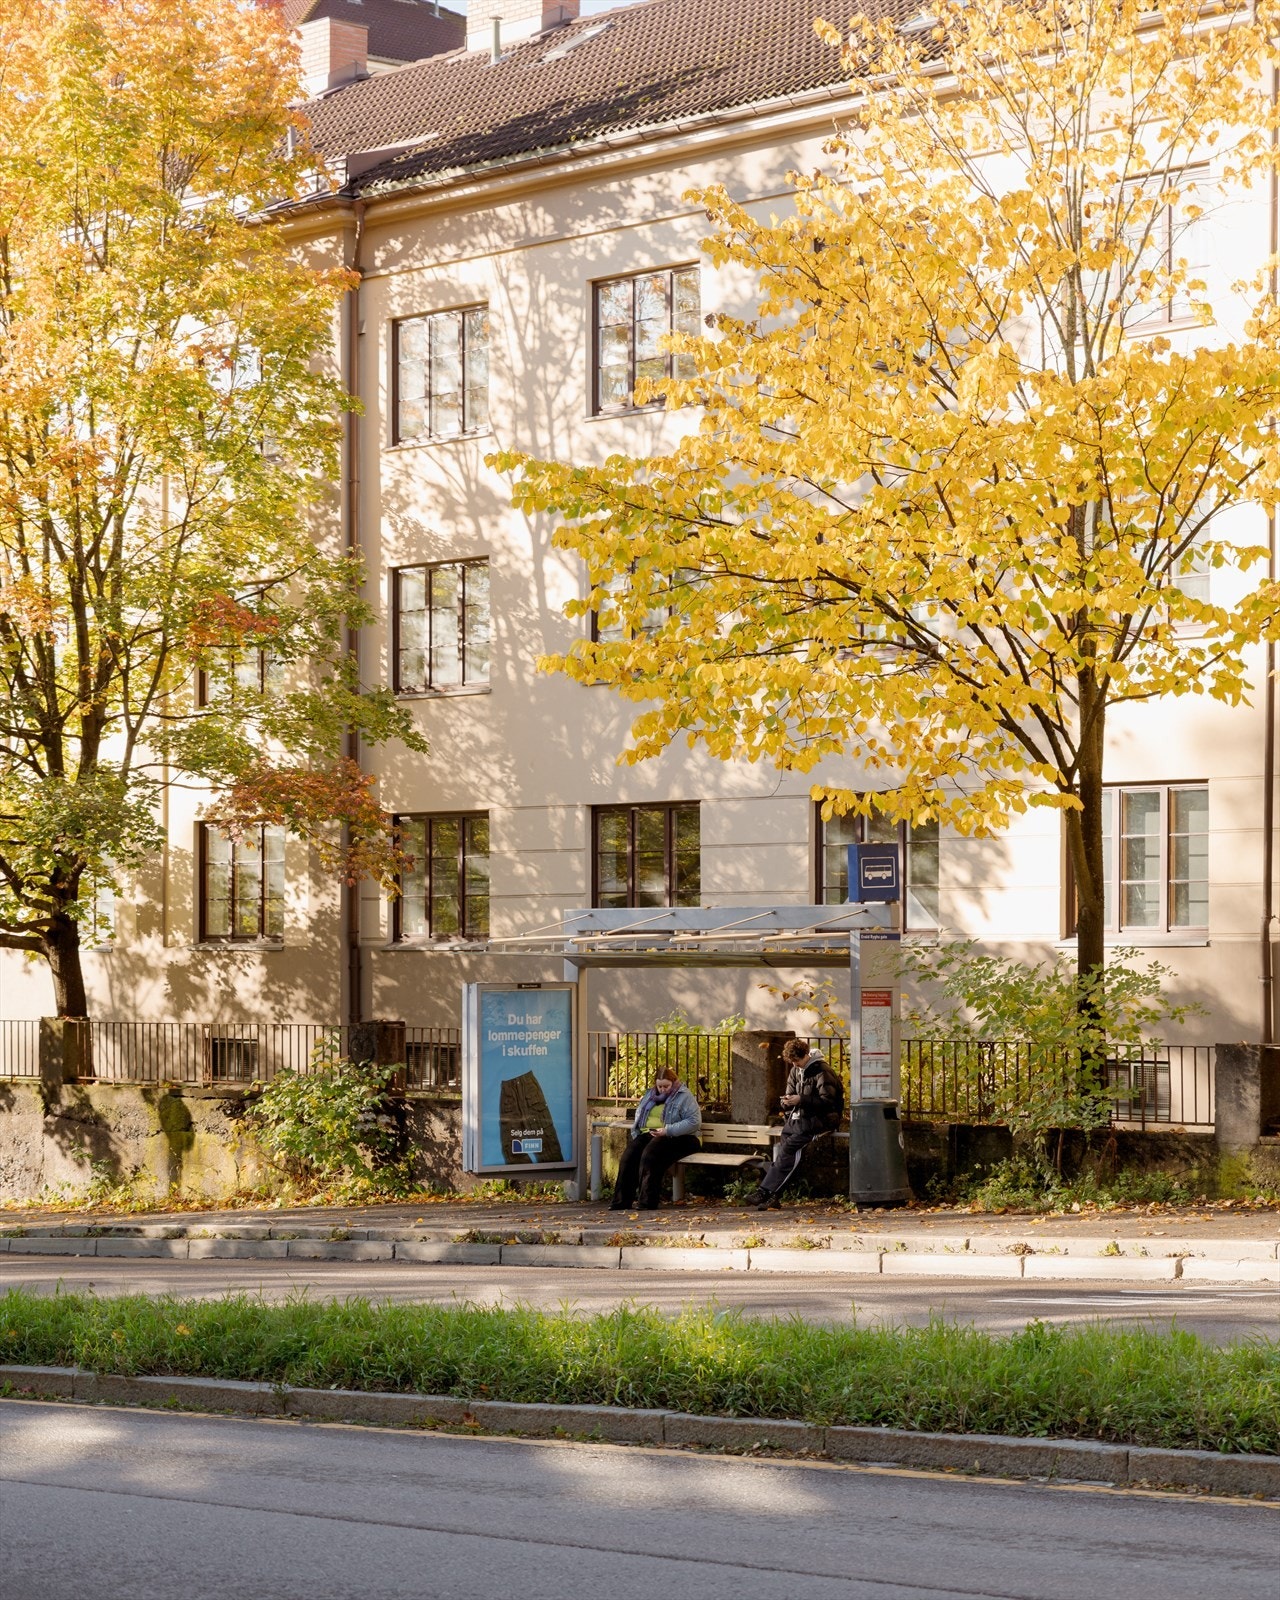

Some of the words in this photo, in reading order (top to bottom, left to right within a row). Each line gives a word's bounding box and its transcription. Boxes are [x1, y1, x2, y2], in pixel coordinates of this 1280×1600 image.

[508, 1013, 524, 1025] Du
[526, 1013, 542, 1025] har
[488, 1030, 562, 1043] lommepenger
[502, 1045, 506, 1056] i
[508, 1044, 548, 1056] skuffen
[536, 1128, 544, 1136] på
